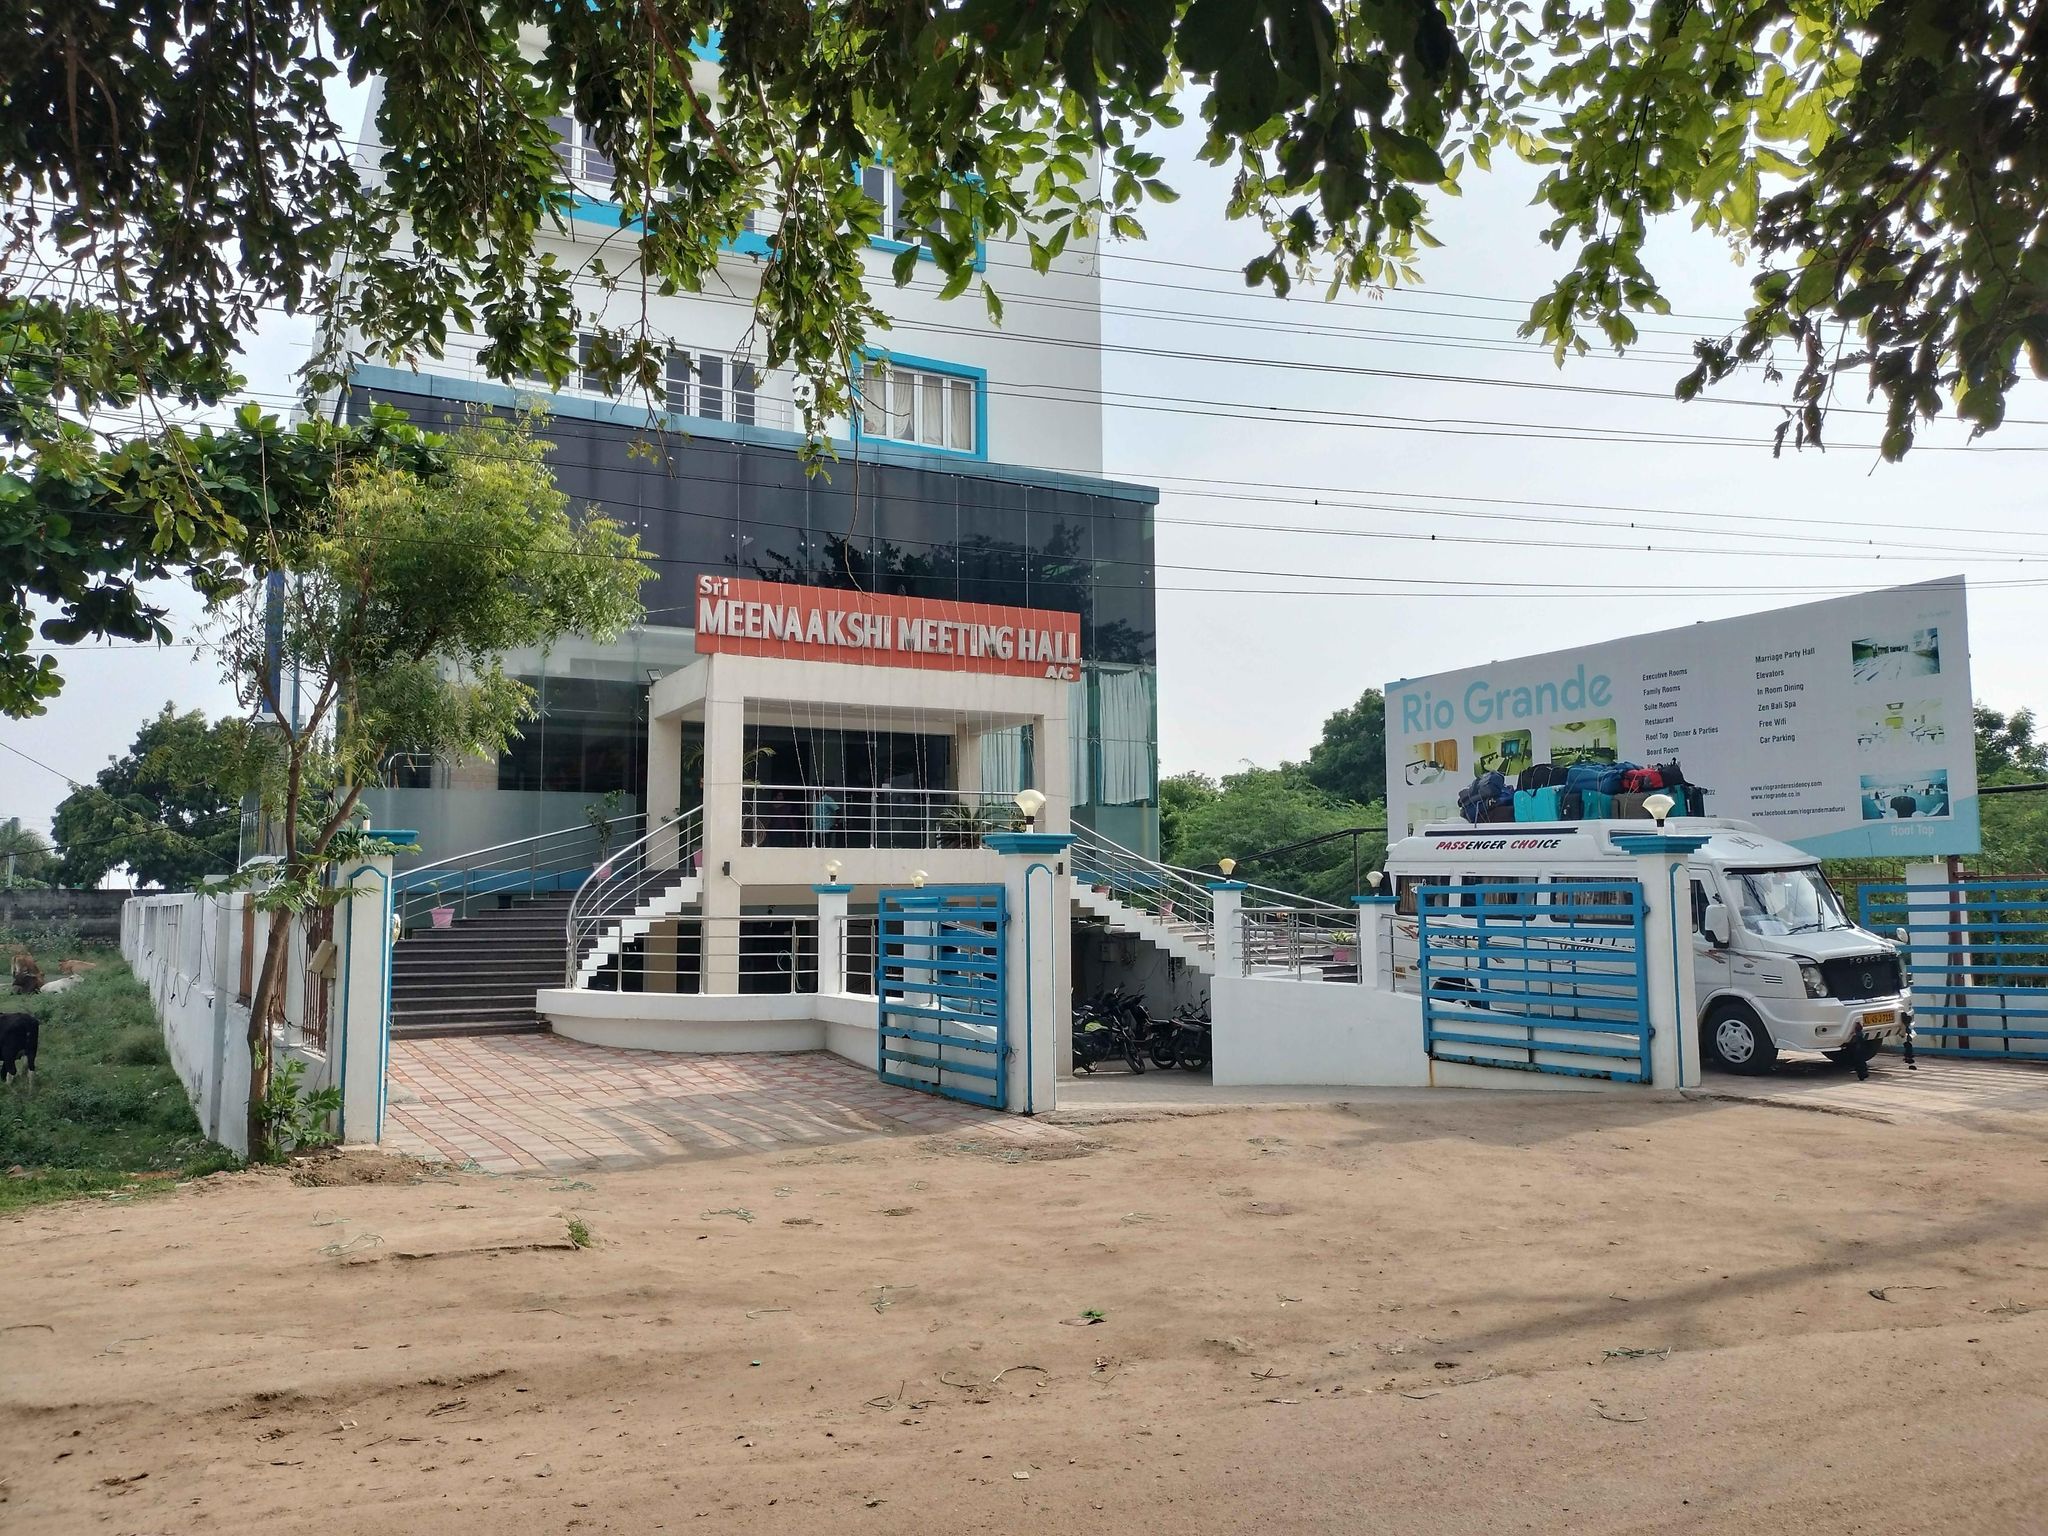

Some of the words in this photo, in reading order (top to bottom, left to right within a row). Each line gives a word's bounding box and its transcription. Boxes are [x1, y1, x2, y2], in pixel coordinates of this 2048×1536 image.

[699, 575, 729, 597] Sri
[699, 597, 891, 650] MEENAAKSHI
[897, 617, 1014, 660] MEETING
[1017, 627, 1082, 664] HALL
[1755, 653, 1783, 664] Marriage
[1784, 650, 1801, 659] Party
[1802, 647, 1816, 656] Hall
[1044, 664, 1074, 680] A/C
[1642, 671, 1668, 682] Executive
[1668, 668, 1688, 677] Rooms
[1756, 669, 1785, 680] Elevators
[1643, 688, 1661, 696] Family
[1662, 685, 1681, 693] Rooms
[1764, 686, 1783, 695] Room
[1783, 683, 1804, 692] Dining
[1402, 691, 1455, 734] Rio
[1464, 664, 1613, 725] Grande
[1644, 703, 1658, 711] Suite
[1658, 700, 1678, 709] Rooms
[1758, 704, 1770, 712] Zen
[1770, 701, 1783, 710] Bali
[1784, 700, 1797, 709] Spa
[1644, 716, 1674, 726] Restaurant
[1759, 720, 1773, 728] Free
[1773, 717, 1787, 726] Wifi
[1645, 733, 1659, 741] Roof
[1659, 732, 1669, 740] Top
[1673, 729, 1691, 738] Dinner
[1698, 726, 1719, 735] Parties
[1759, 736, 1771, 744] Car
[1772, 733, 1796, 743] Parking
[1646, 748, 1662, 756] Board
[1663, 746, 1680, 754] Room
[1750, 781, 1823, 791] www.riogranderesidency.com
[1751, 791, 1801, 800] www.riogrande.co.in
[1891, 825, 1914, 836] Roof
[1917, 825, 1935, 836] Top
[1435, 840, 1507, 850] PASSENGER
[1510, 839, 1562, 849] CHOICE
